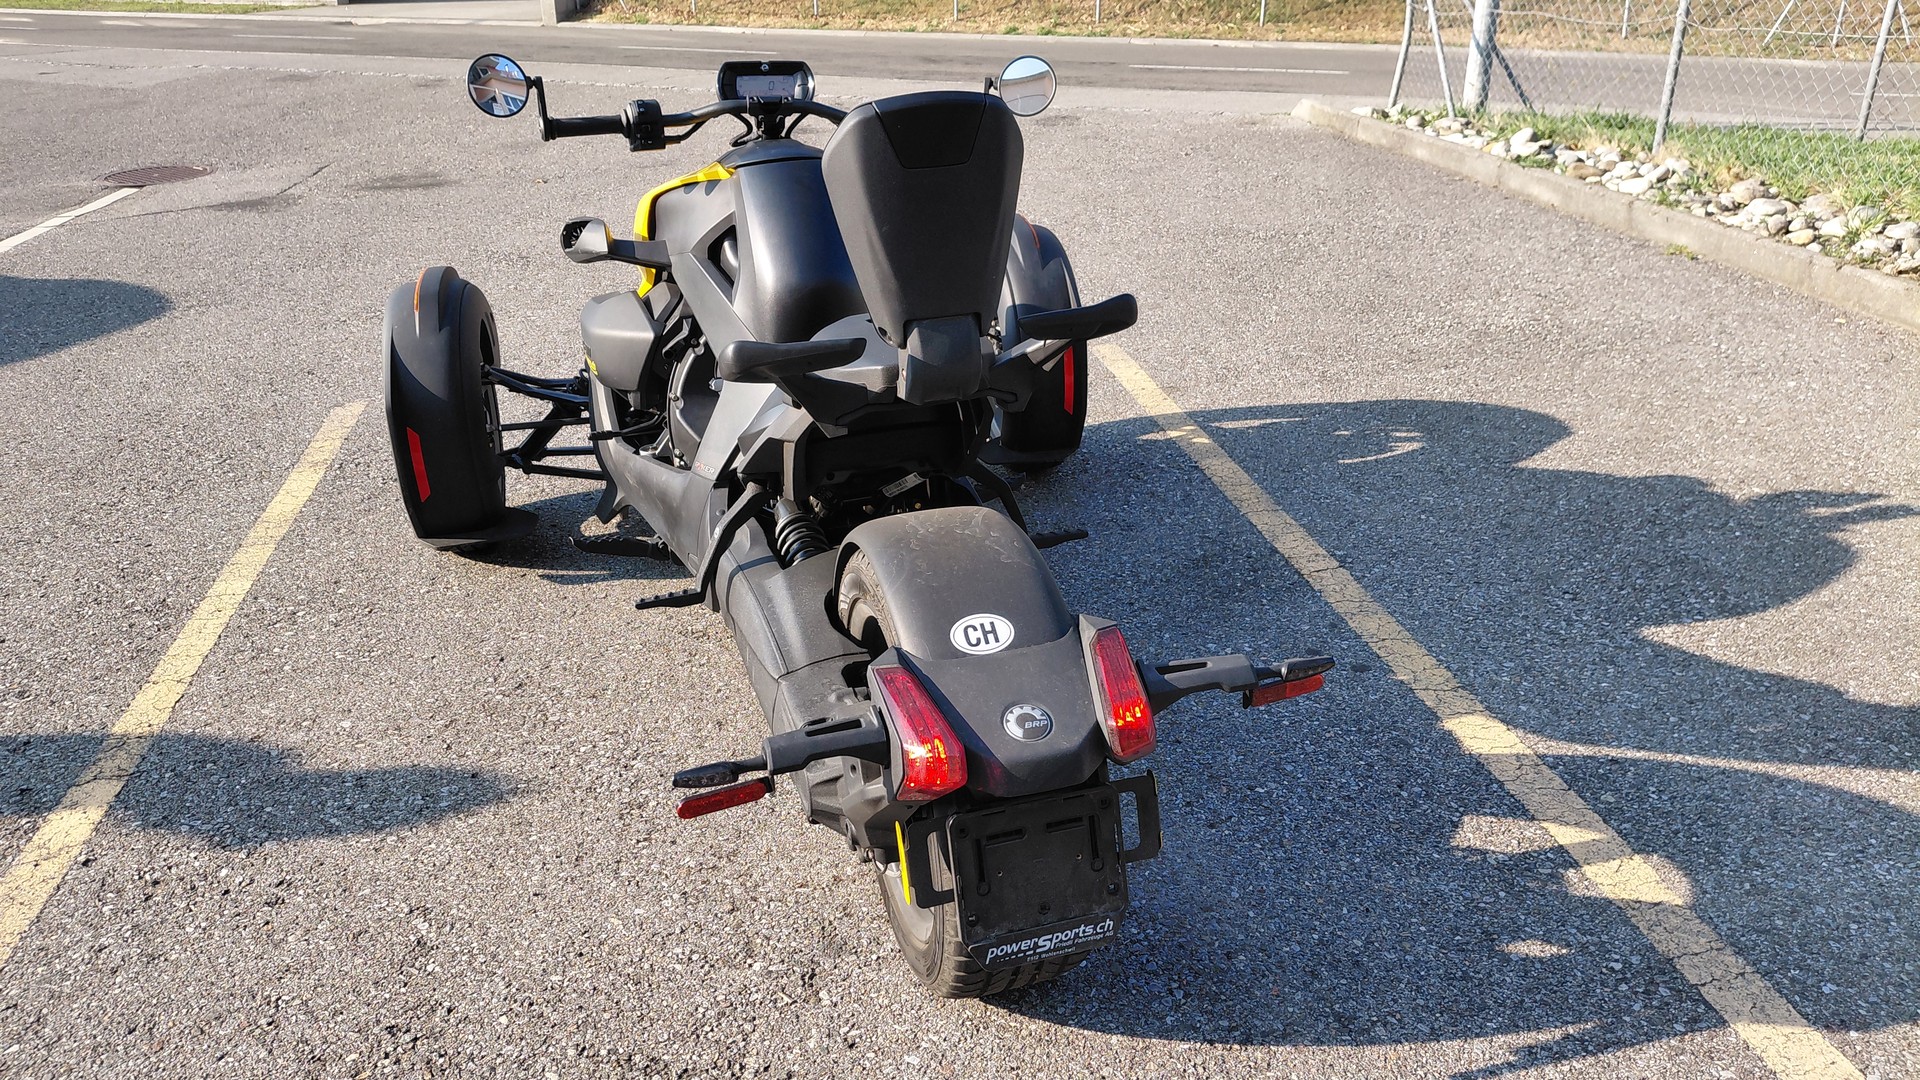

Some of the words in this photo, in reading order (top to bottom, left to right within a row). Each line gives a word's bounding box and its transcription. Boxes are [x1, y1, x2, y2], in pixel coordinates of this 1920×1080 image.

[963, 621, 1000, 648] CH
[1024, 719, 1048, 729] BRP
[985, 918, 1114, 965] powerSports.ch
[1105, 930, 1114, 938] AG
